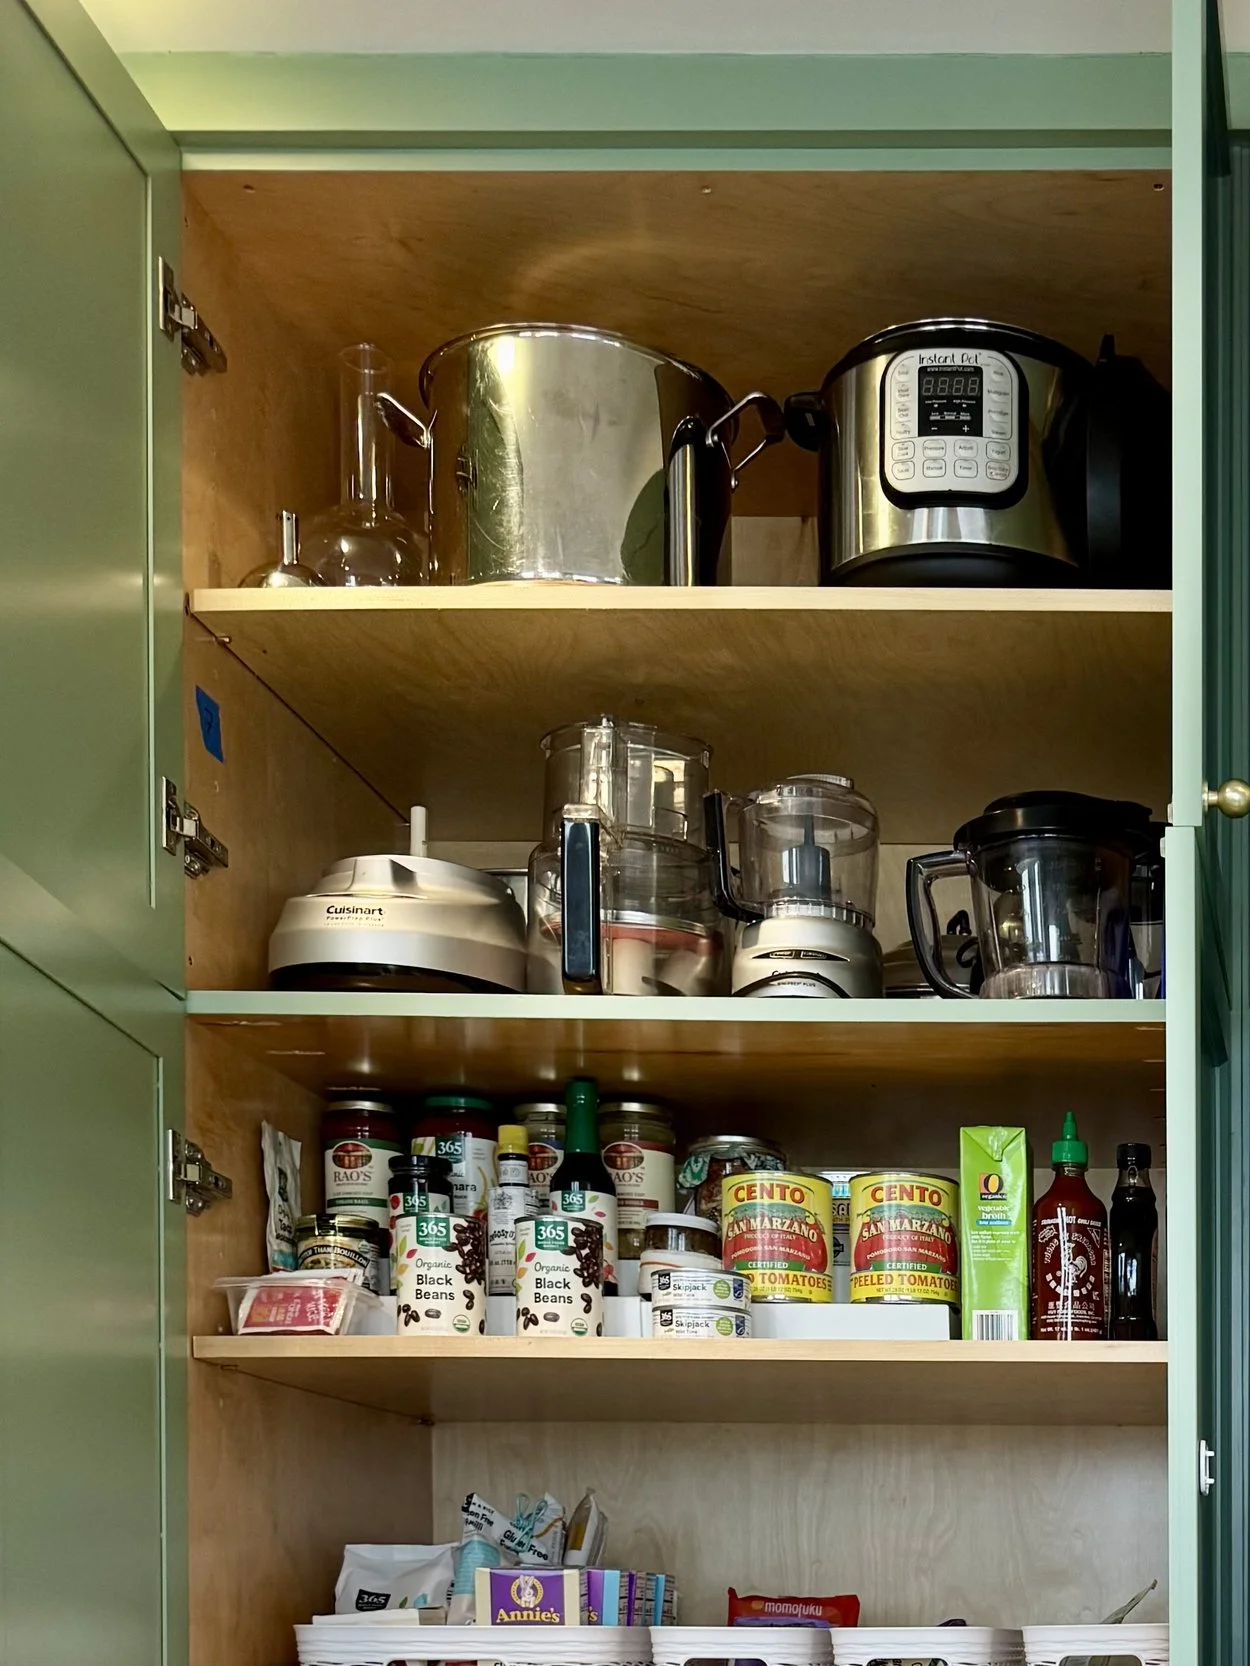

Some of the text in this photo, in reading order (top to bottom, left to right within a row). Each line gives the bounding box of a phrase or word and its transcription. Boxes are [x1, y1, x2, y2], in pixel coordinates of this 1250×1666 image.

[919, 353, 979, 365] Instant Pot
[326, 904, 384, 916] Cuisinart
[437, 1141, 462, 1155] 365
[334, 1170, 372, 1182] RAO'S
[563, 1193, 584, 1205] 365
[734, 1182, 806, 1204] CENTO
[871, 1184, 943, 1207] CENTO
[405, 1196, 426, 1208] 365
[982, 1212, 1006, 1220] broth
[418, 1222, 448, 1237] 365
[537, 1225, 565, 1240] 365
[727, 1216, 818, 1243] SAN MARZANO
[862, 1218, 952, 1245] SAN MARZANO
[314, 1246, 369, 1268] THAN BOUILLON
[416, 1258, 452, 1271] Organic
[534, 1262, 570, 1274] Organic
[886, 1262, 928, 1270] CERTIFIED
[416, 1274, 452, 1286] Black
[535, 1278, 570, 1290] Black
[760, 1273, 827, 1290] TOMATOES
[854, 1274, 894, 1288] PEELED
[416, 1288, 456, 1301] Beans
[672, 1284, 707, 1294] Skipjack
[534, 1292, 574, 1304] Beans
[674, 1320, 710, 1330] Skipjack
[528, 1544, 549, 1561] Free
[358, 1594, 387, 1604] 365
[496, 1607, 560, 1624] Annie's
[764, 1601, 822, 1617] momofuku
